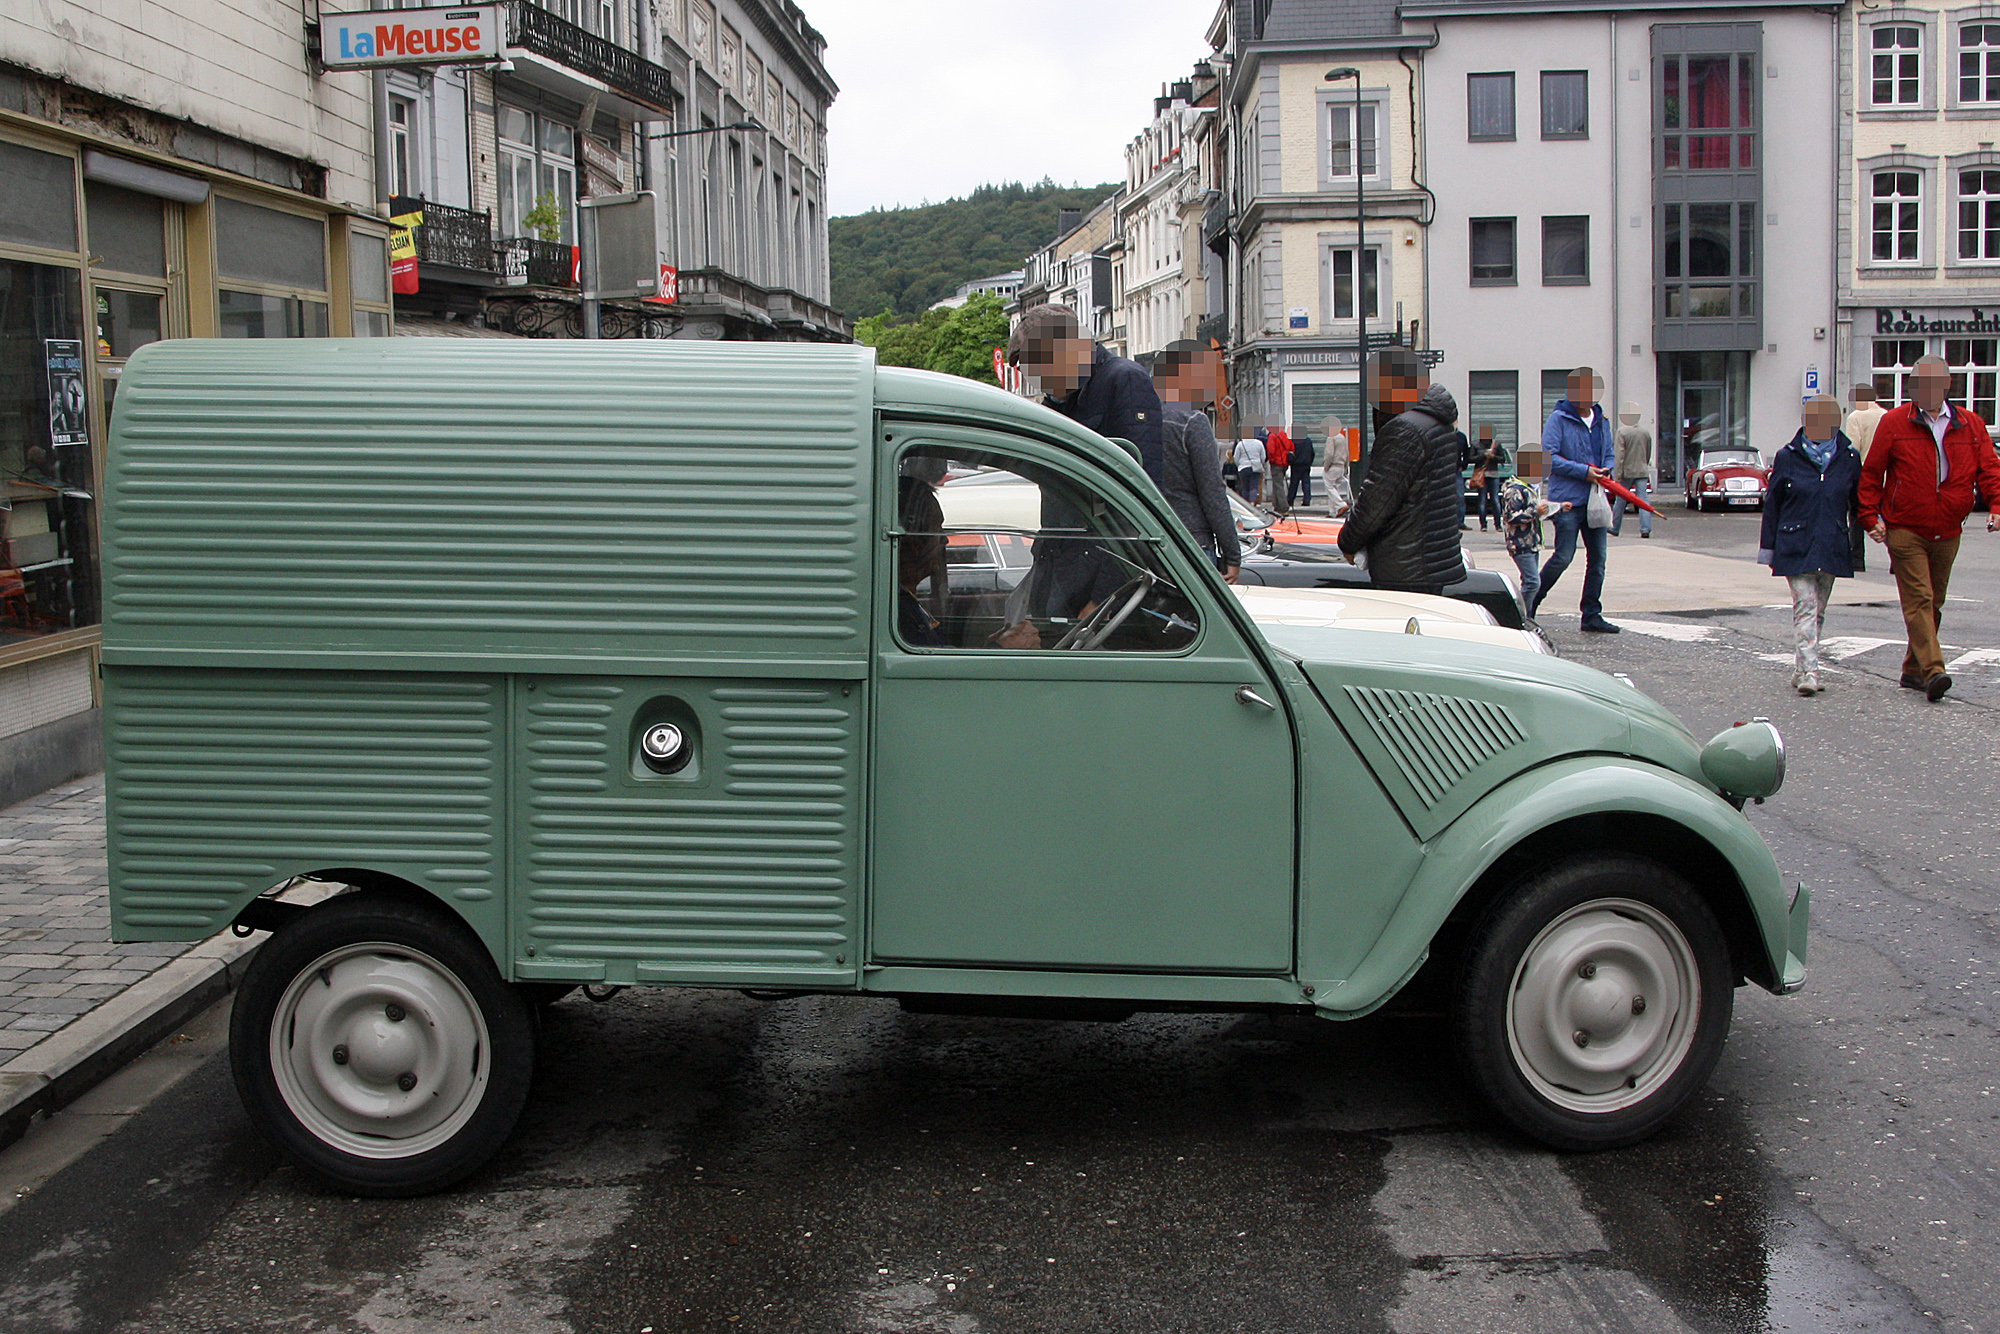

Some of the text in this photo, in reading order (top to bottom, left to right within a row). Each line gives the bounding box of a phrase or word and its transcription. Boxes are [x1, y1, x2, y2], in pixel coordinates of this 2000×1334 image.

[339, 24, 481, 59] LaMeuse
[390, 234, 411, 251] ELGIAN
[1876, 308, 2000, 334] Restaurant
[1285, 352, 1342, 365] JOAILLERIE
